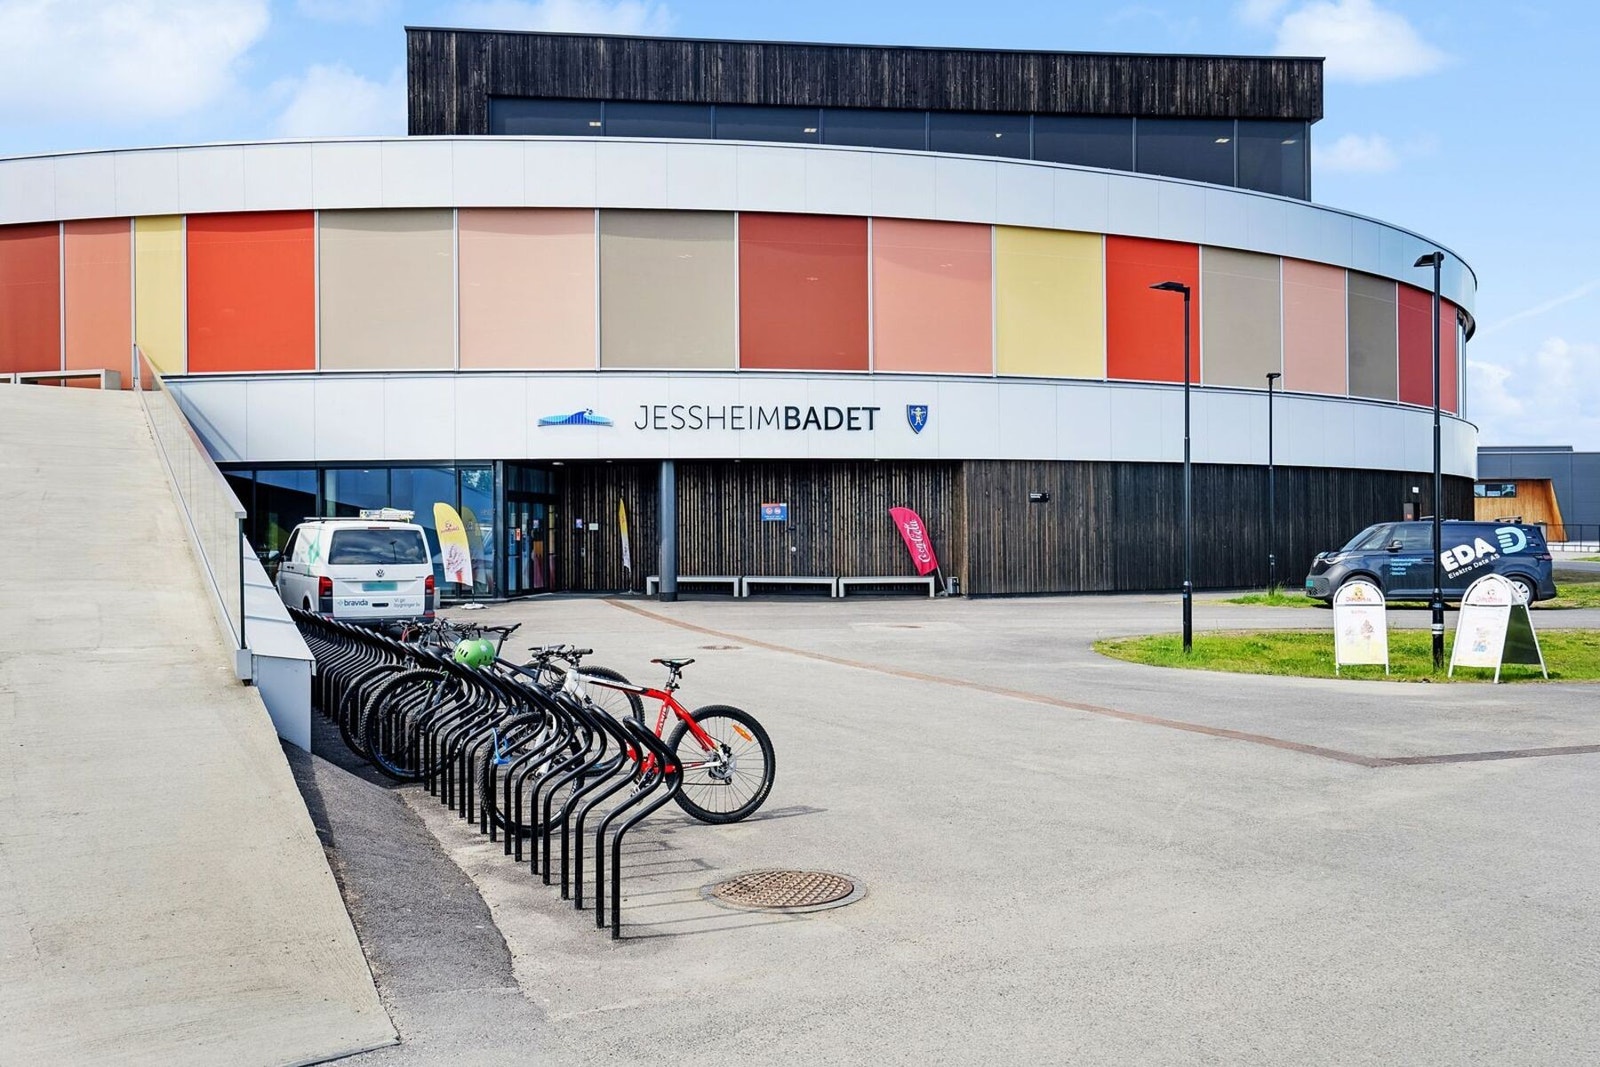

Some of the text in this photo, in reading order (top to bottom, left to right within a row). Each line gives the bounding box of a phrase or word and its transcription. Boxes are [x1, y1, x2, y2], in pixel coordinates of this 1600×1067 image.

[634, 405, 880, 430] JESSHEIMBADET
[1440, 537, 1496, 572] EDA
[1448, 553, 1500, 580] Elektro Data AS
[344, 599, 368, 607] bravida
